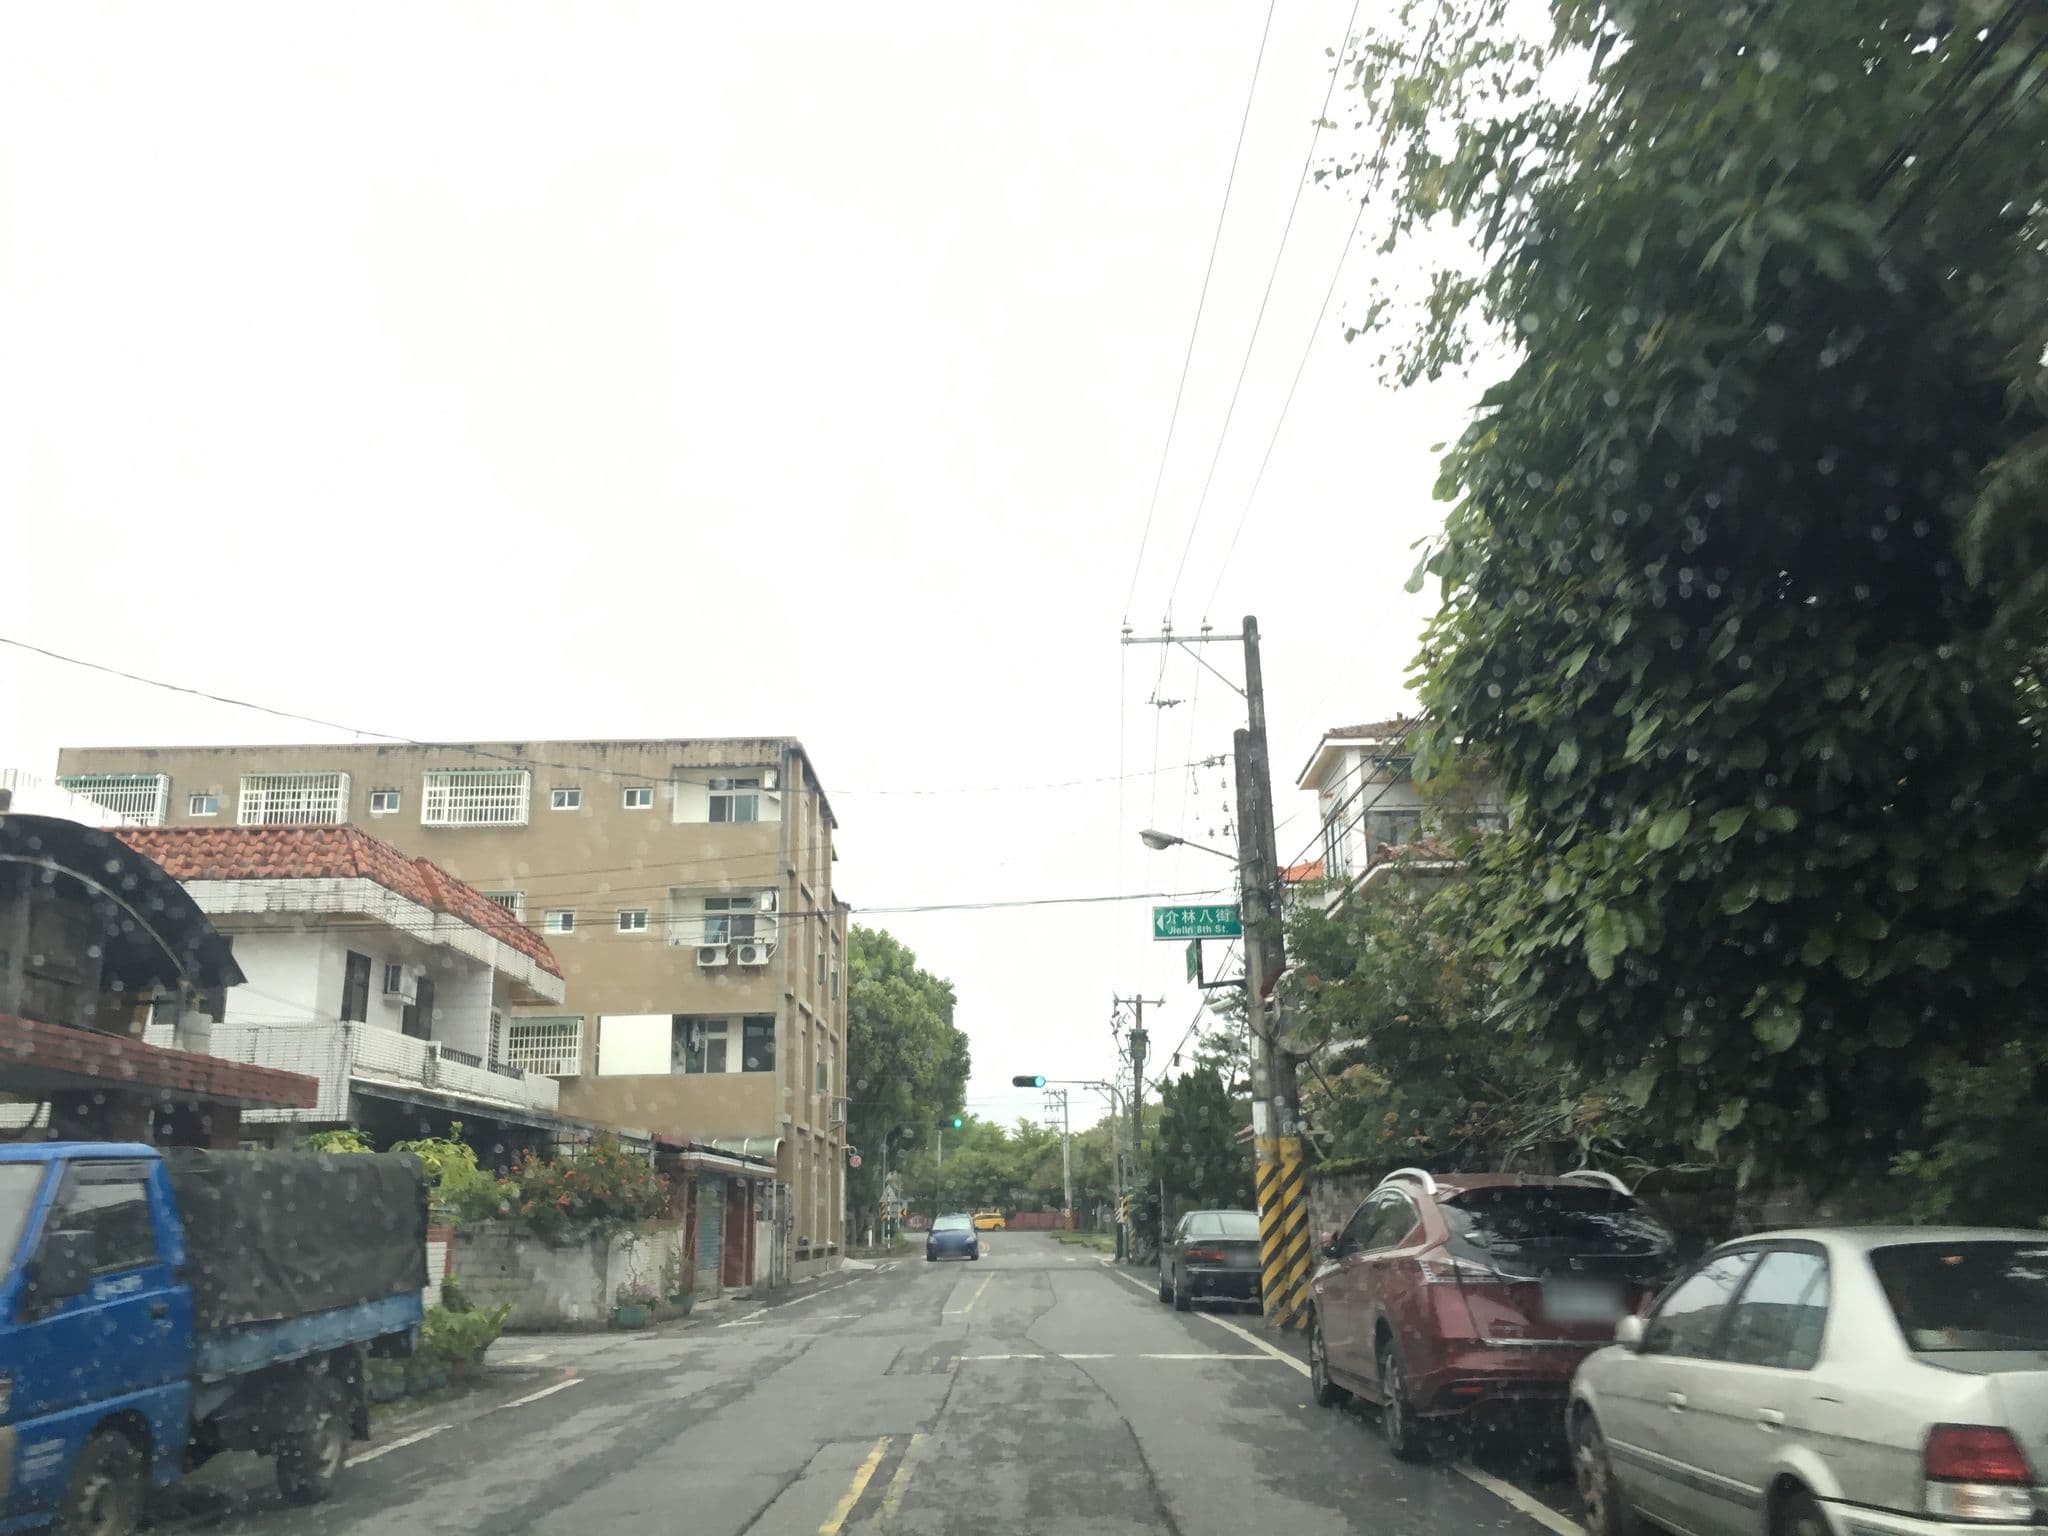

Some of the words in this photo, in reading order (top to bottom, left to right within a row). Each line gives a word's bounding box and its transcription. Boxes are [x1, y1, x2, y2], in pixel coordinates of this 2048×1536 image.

[1165, 909, 1230, 924] 介林八街
[1197, 925, 1212, 934] 8th
[1215, 924, 1229, 933] St.
